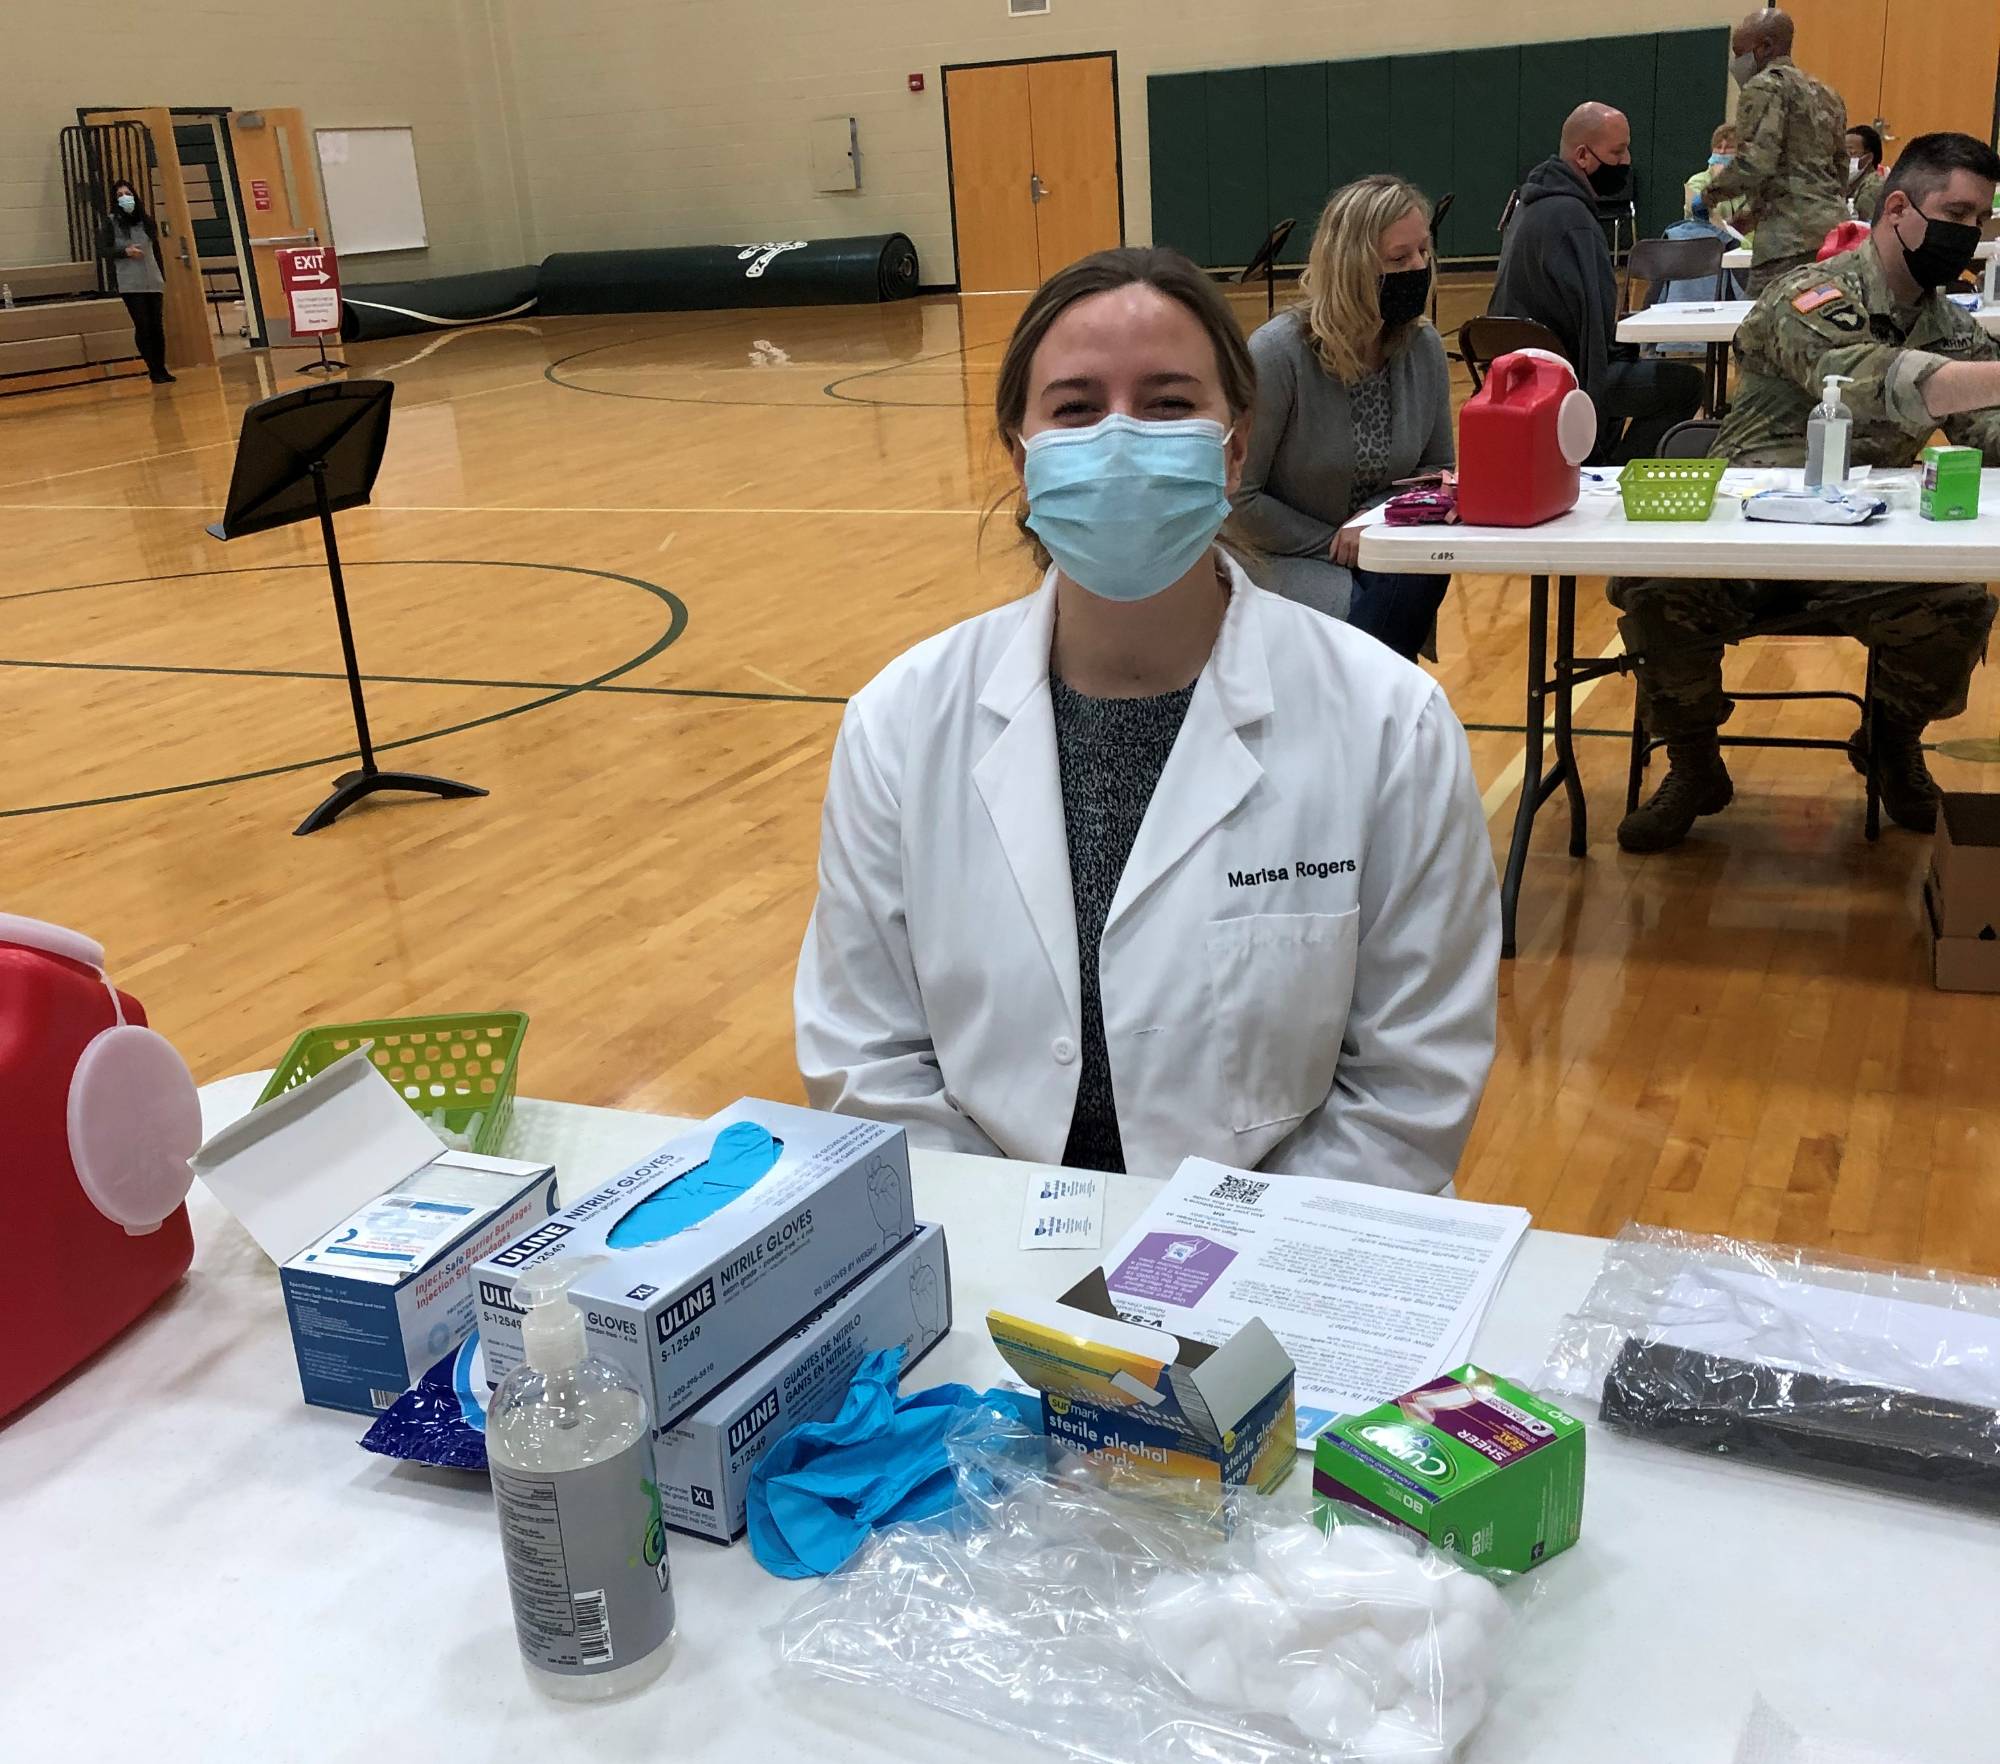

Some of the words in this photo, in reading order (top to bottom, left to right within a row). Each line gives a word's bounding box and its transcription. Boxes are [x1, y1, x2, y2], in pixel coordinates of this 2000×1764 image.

[294, 255, 324, 270] EXIT
[1944, 336, 1974, 349] ARMY
[1431, 552, 1454, 560] CAPS
[1228, 868, 1289, 888] Marisa
[1296, 860, 1356, 878] Rogers
[564, 1188, 618, 1220] NITRILE
[618, 1154, 674, 1188] GLOVES
[466, 1232, 494, 1258] Barrier
[495, 1202, 532, 1236] Bandages
[498, 1224, 568, 1267] ULINE
[720, 1244, 763, 1286] NITRILE
[766, 1209, 812, 1252] GLOVES
[417, 1277, 455, 1309] Injection
[631, 1286, 654, 1300] XL
[824, 1267, 847, 1290] GLOVES
[484, 1312, 522, 1330] S-12549
[588, 1312, 636, 1336] GLOVES
[660, 1284, 712, 1336] ULINE
[1120, 1312, 1162, 1328] v-sa
[662, 1326, 700, 1362] S-12549
[784, 1351, 820, 1389] GUANTES
[820, 1339, 832, 1357] DE
[833, 1314, 861, 1346] NITRILO
[785, 1374, 812, 1404] GANTS
[814, 1361, 824, 1380] EN
[826, 1336, 852, 1369] NITRILE
[731, 1394, 776, 1449] ULINE
[1052, 1398, 1098, 1422] sunmark
[1547, 1410, 1574, 1426] 80
[1049, 1414, 1098, 1442] sterile
[1104, 1432, 1168, 1464] alcohol
[1252, 1436, 1274, 1470] pads
[1457, 1428, 1508, 1462] SHEER
[1501, 1431, 1527, 1450] SEAL
[732, 1436, 766, 1473] S-12549
[1225, 1440, 1254, 1474] sterile
[694, 1489, 712, 1506] XL
[1403, 1495, 1424, 1514] 80
[1472, 1531, 1482, 1557] 80
